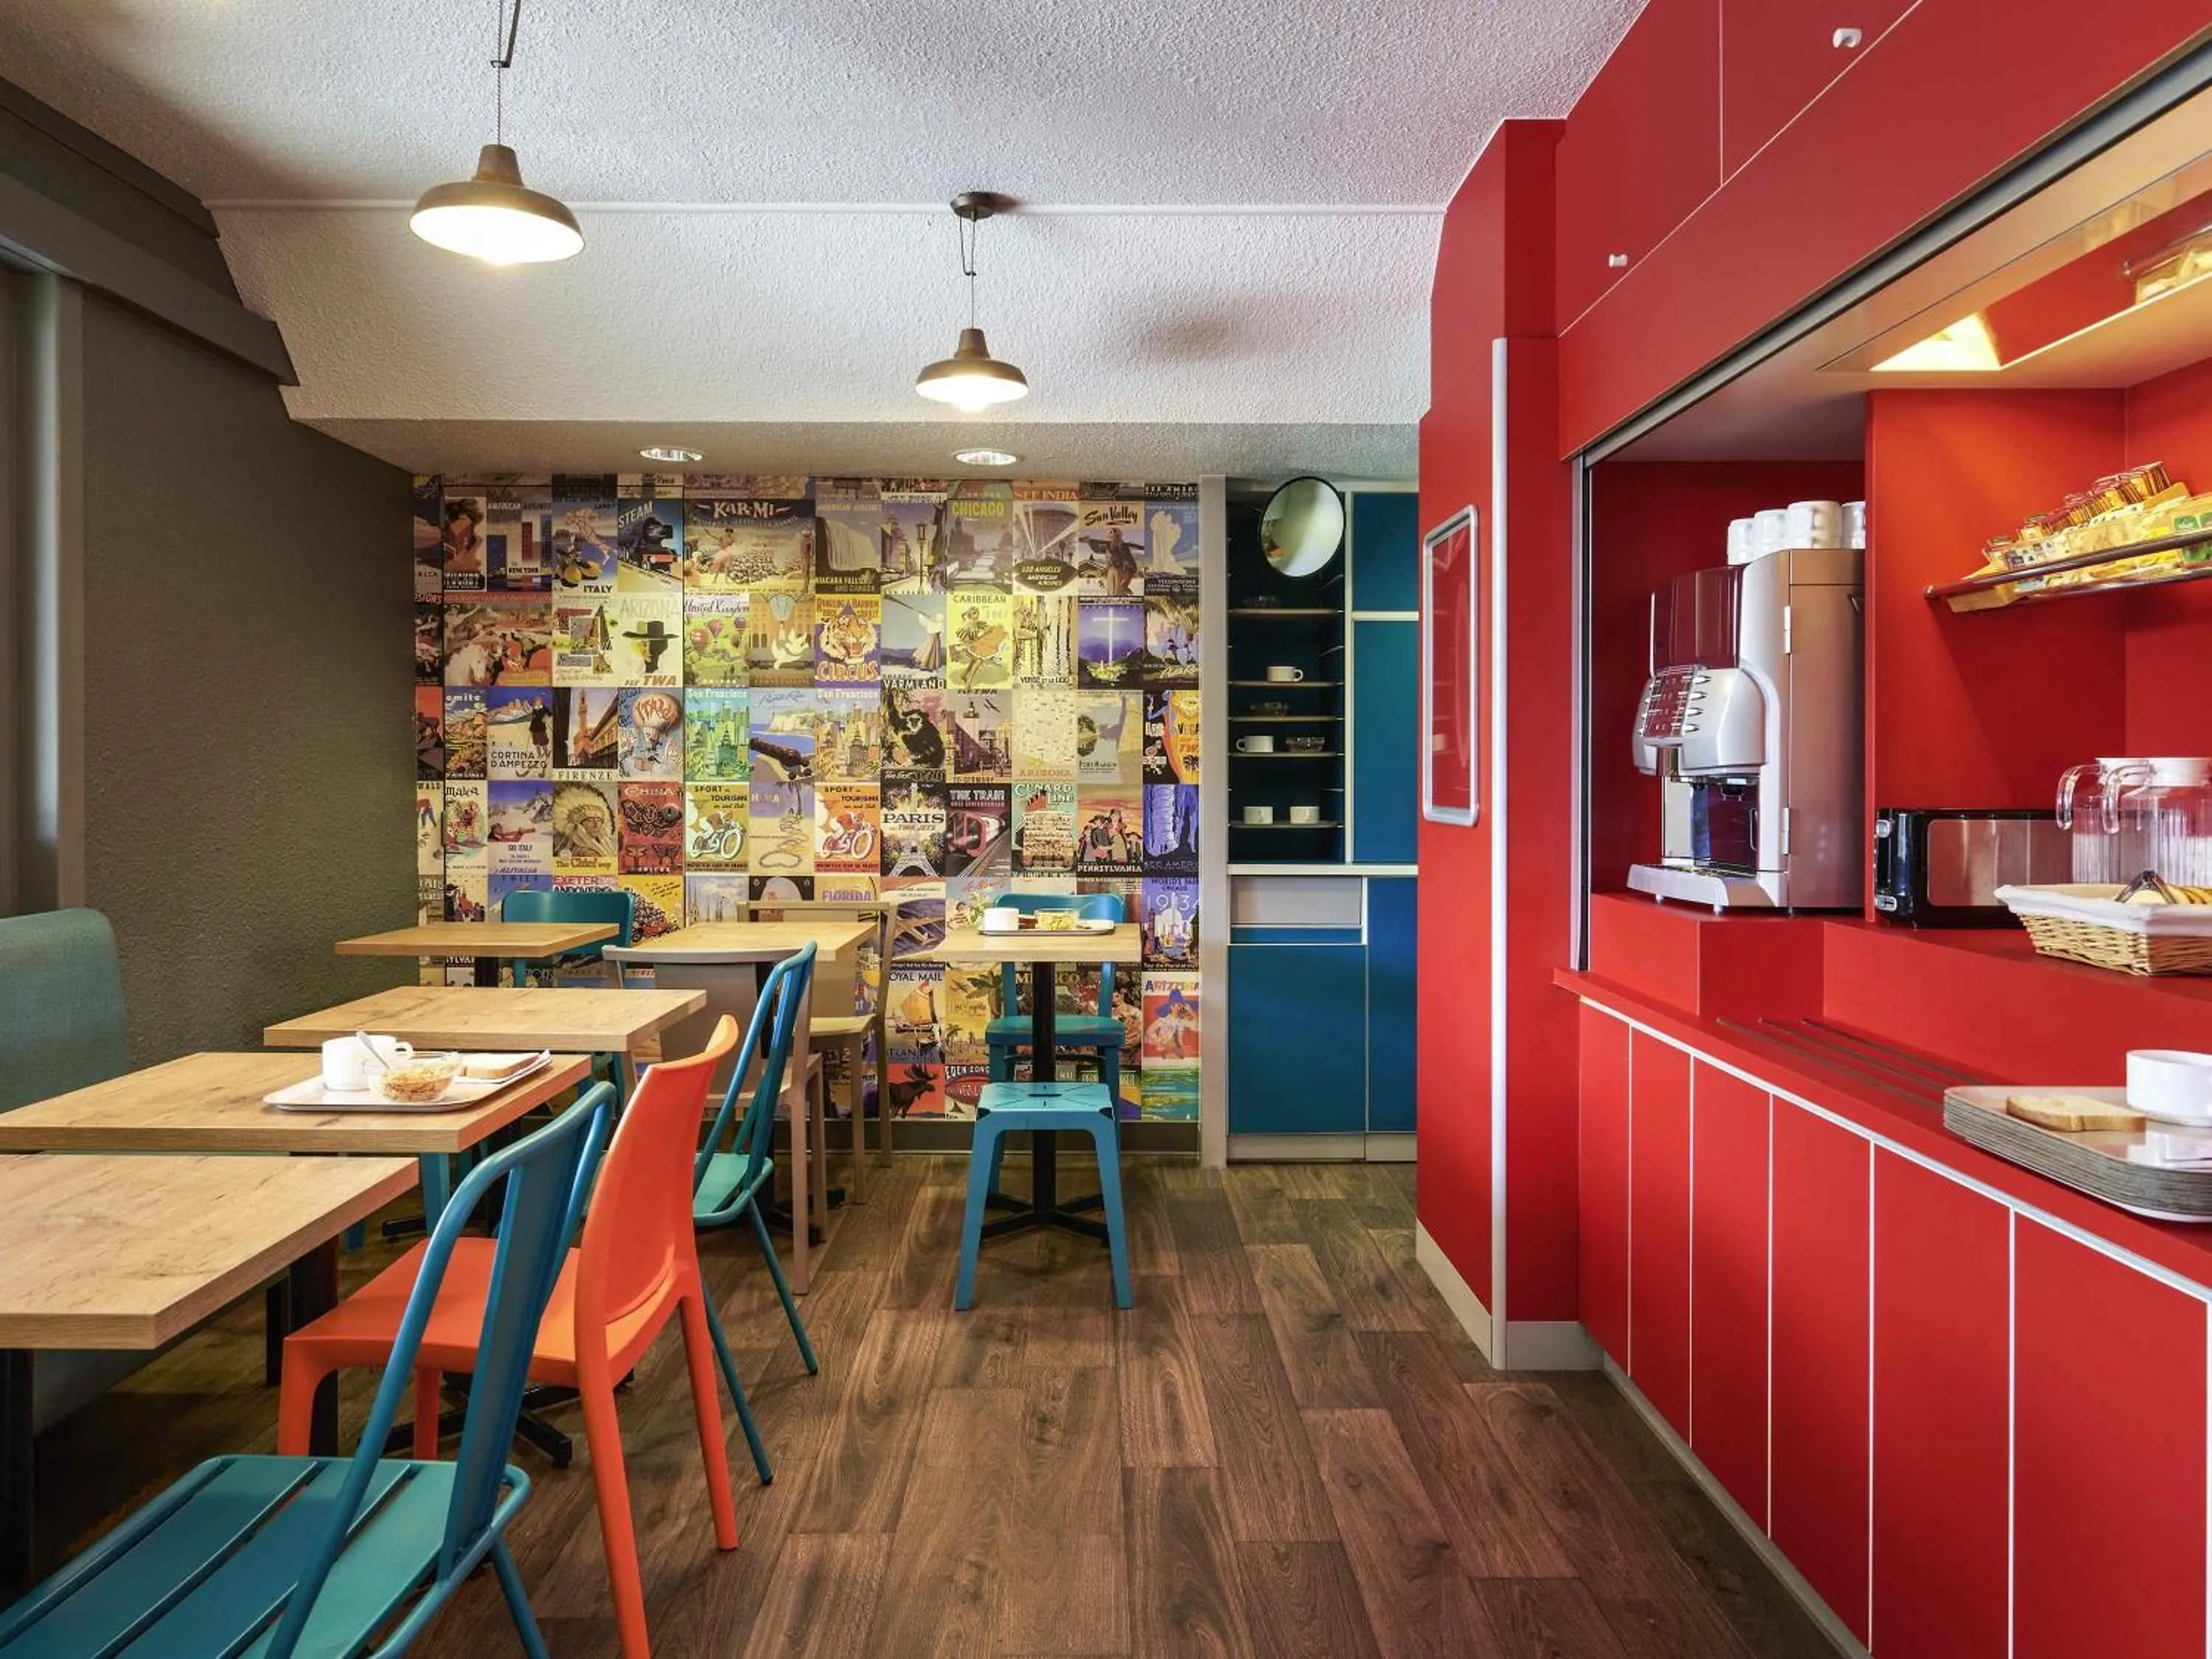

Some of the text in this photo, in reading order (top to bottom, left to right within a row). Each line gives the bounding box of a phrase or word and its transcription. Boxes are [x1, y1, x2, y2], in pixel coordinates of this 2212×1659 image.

[1043, 490, 1079, 501] INDIA
[712, 501, 774, 518] KAR-MI
[952, 501, 1004, 516] CHICAGO
[618, 501, 653, 529] STEAM
[583, 585, 613, 593] ITALY
[953, 595, 1007, 604] CARIBBEAN
[816, 660, 878, 681] CIRCUS
[643, 675, 677, 686] TWA
[490, 751, 535, 759] CORTINA
[557, 771, 613, 781] FIRENZE
[625, 786, 675, 796] CHINA
[1015, 784, 1074, 796] CUNARD
[883, 813, 945, 824] PARIS
[1077, 865, 1142, 873] PENNSYLVANIA
[554, 875, 599, 886] EXETER
[821, 890, 872, 901] FLORIDA
[887, 972, 943, 981] OYAL MAIL
[1144, 979, 1200, 992] ARIZONA
